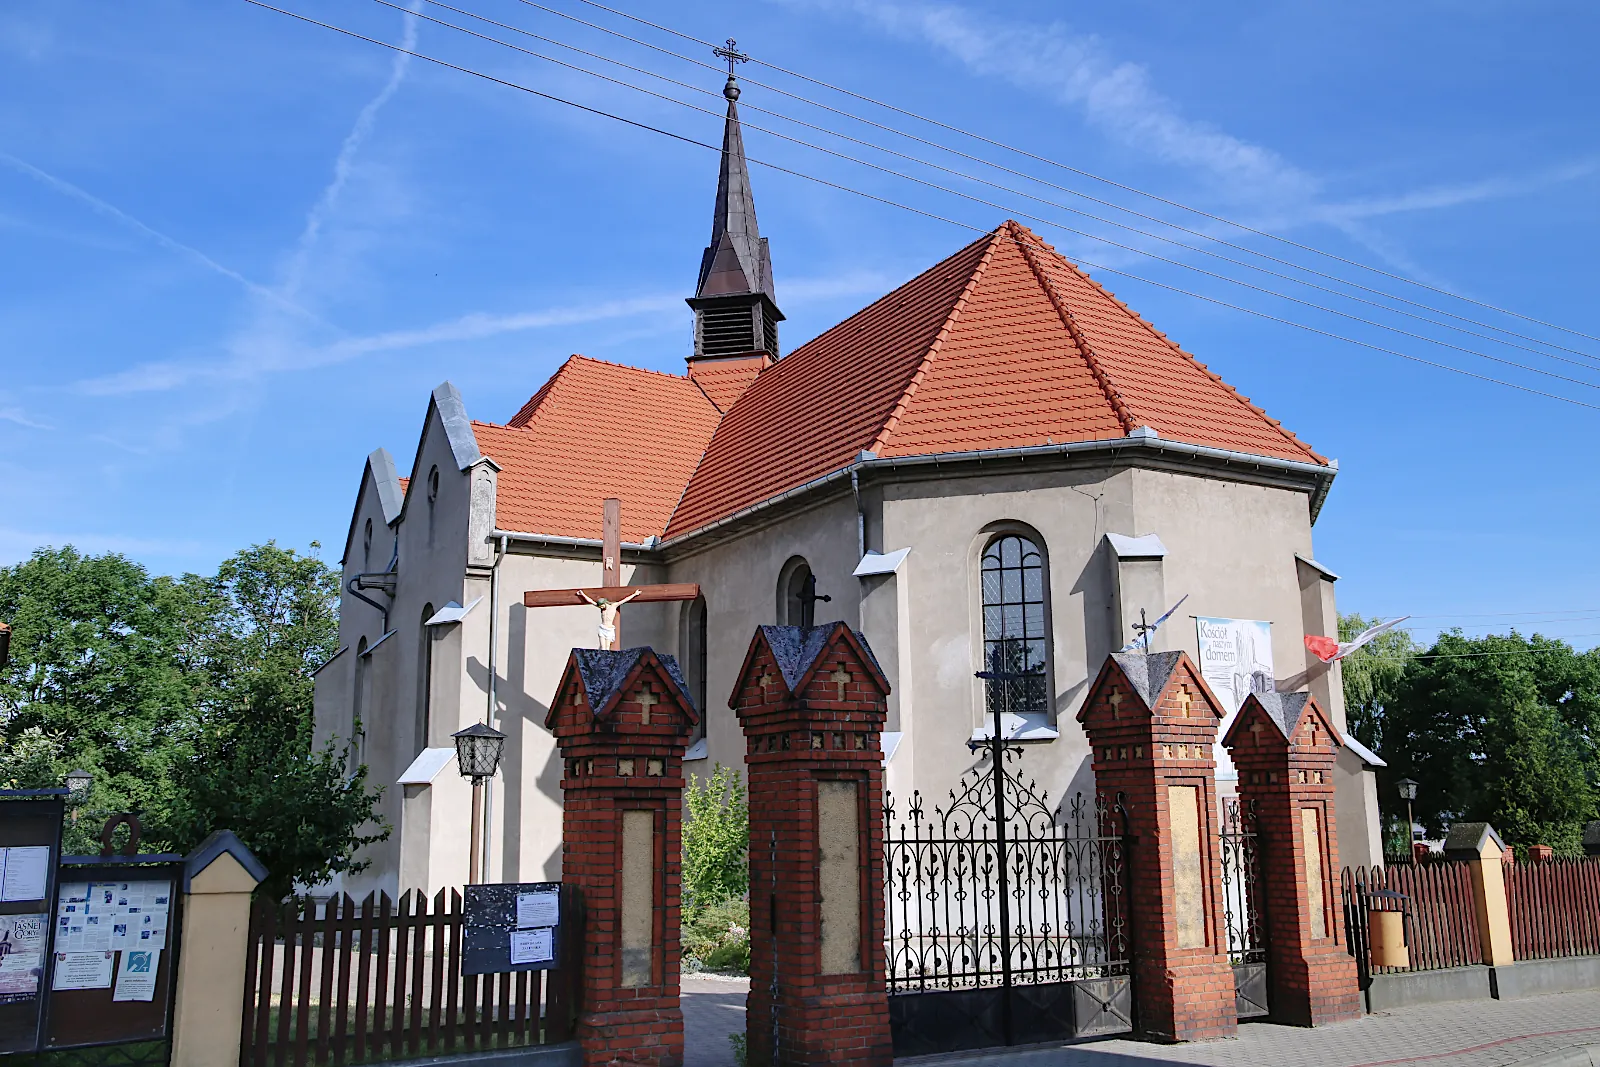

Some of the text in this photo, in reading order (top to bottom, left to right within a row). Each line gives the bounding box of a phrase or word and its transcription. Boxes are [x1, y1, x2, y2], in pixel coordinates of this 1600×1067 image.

[1200, 622, 1228, 639] Kościół
[1206, 645, 1235, 661] domem
[1213, 641, 1232, 650] naszym
